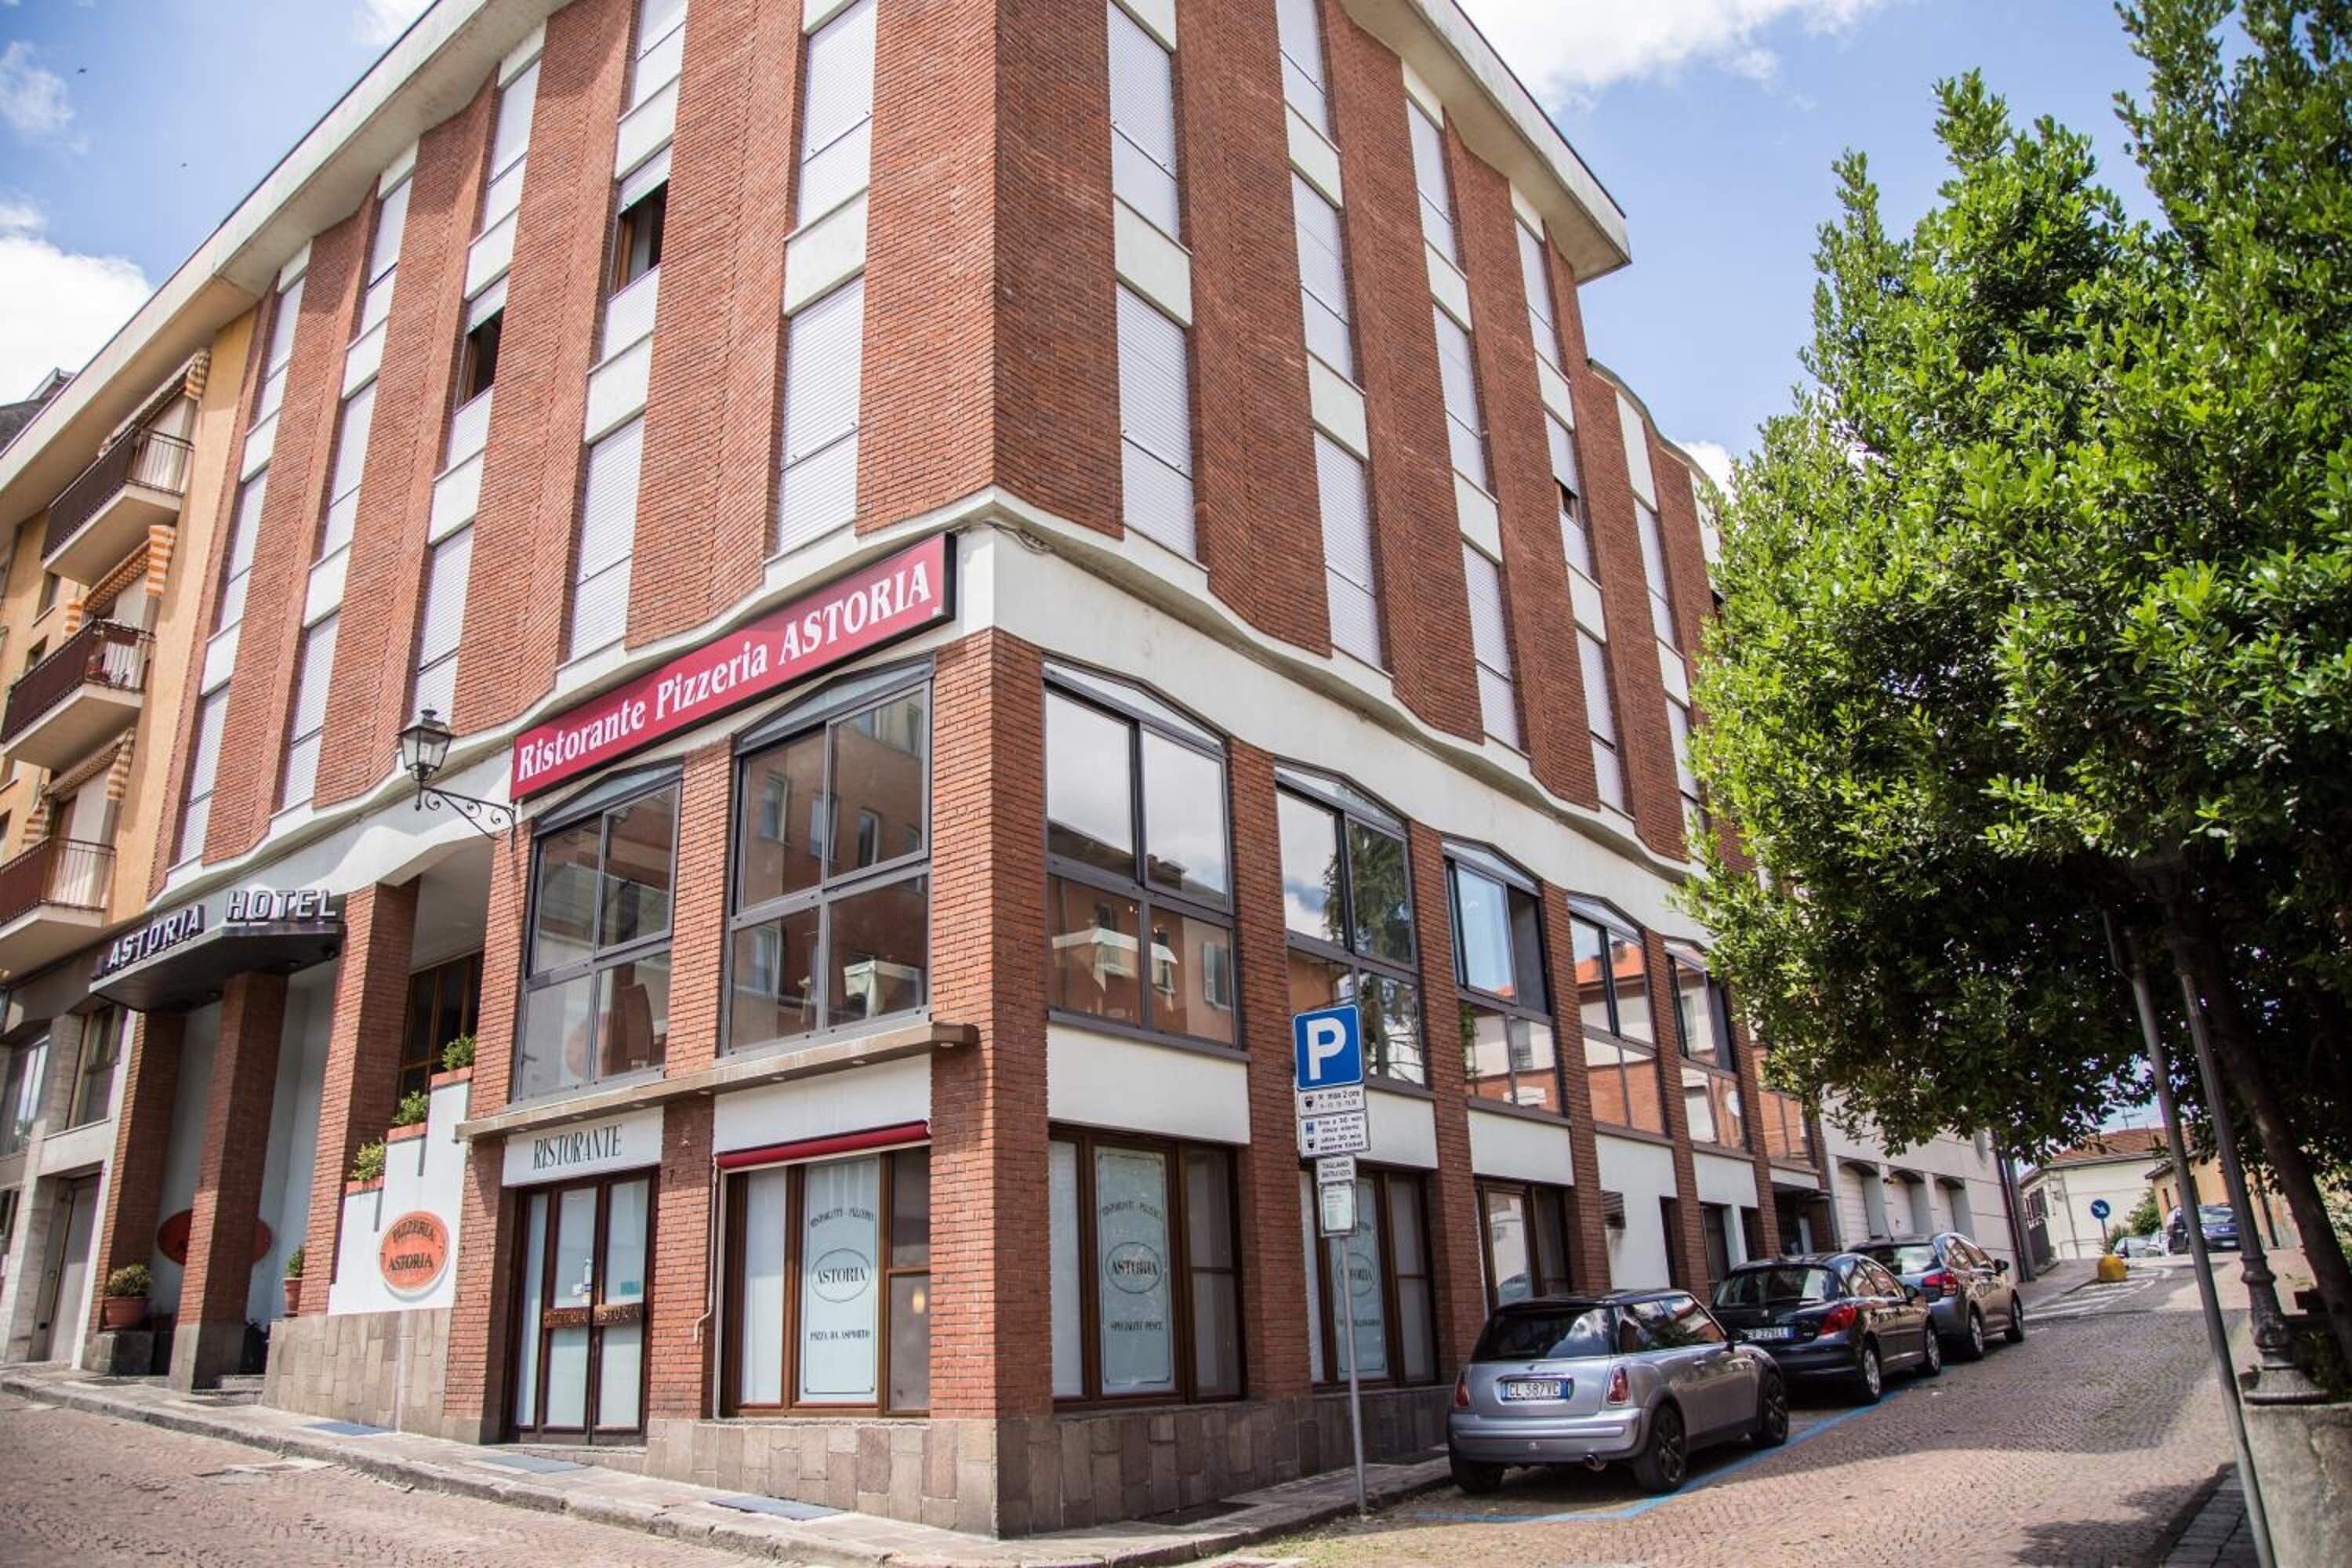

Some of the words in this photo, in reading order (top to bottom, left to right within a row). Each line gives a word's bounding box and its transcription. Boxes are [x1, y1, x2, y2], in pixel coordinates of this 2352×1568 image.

[517, 695, 646, 782] Ristorante
[655, 640, 768, 722] Pizzeria
[779, 560, 932, 665] ASTORIA
[107, 903, 203, 969] ASTORIA
[225, 890, 338, 920] HOTEL
[1307, 1018, 1346, 1080] P
[533, 1123, 622, 1170] RISTORANTE
[393, 1219, 434, 1242] PIZZERIA
[389, 1253, 434, 1271] ASTORIA
[815, 1266, 866, 1284] ASTORIA
[1112, 1260, 1159, 1277] ASTORIA
